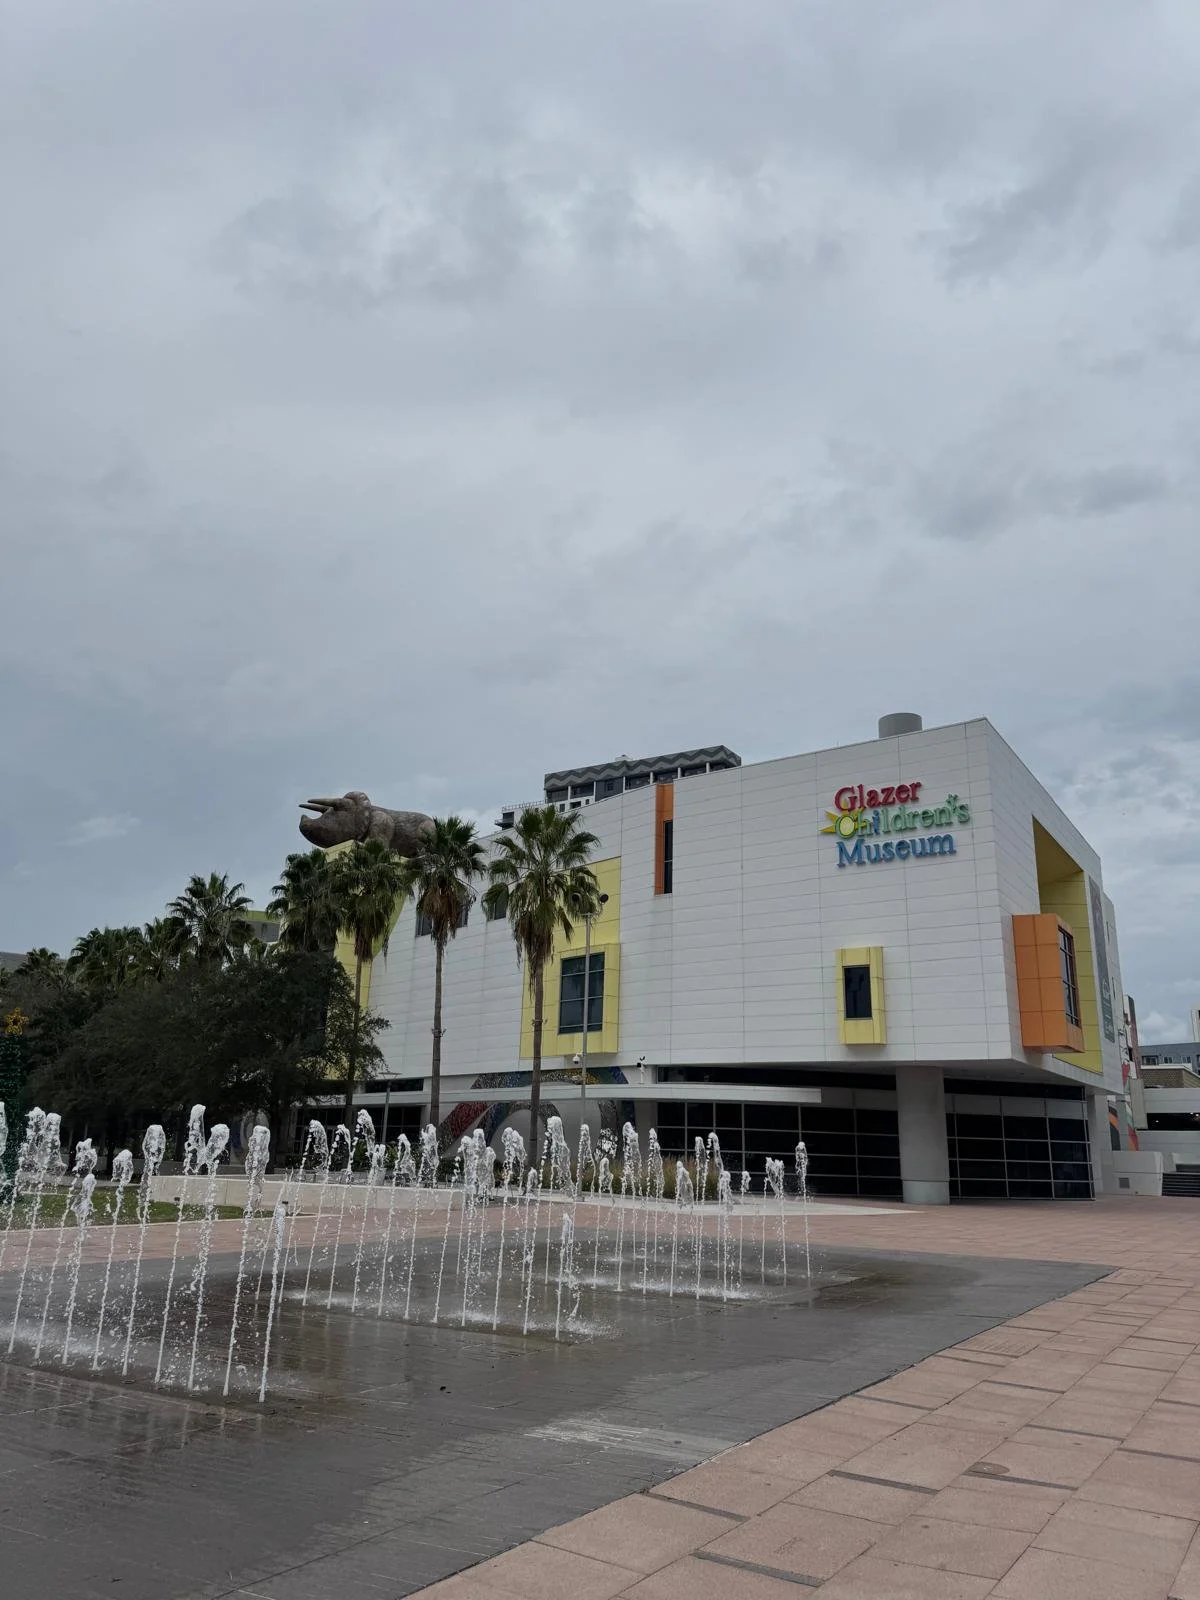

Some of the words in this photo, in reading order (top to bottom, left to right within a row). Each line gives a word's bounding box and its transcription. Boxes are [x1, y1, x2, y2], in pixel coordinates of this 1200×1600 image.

[834, 781, 922, 812] Glazer
[828, 793, 970, 839] Children's
[836, 833, 957, 867] Museum
